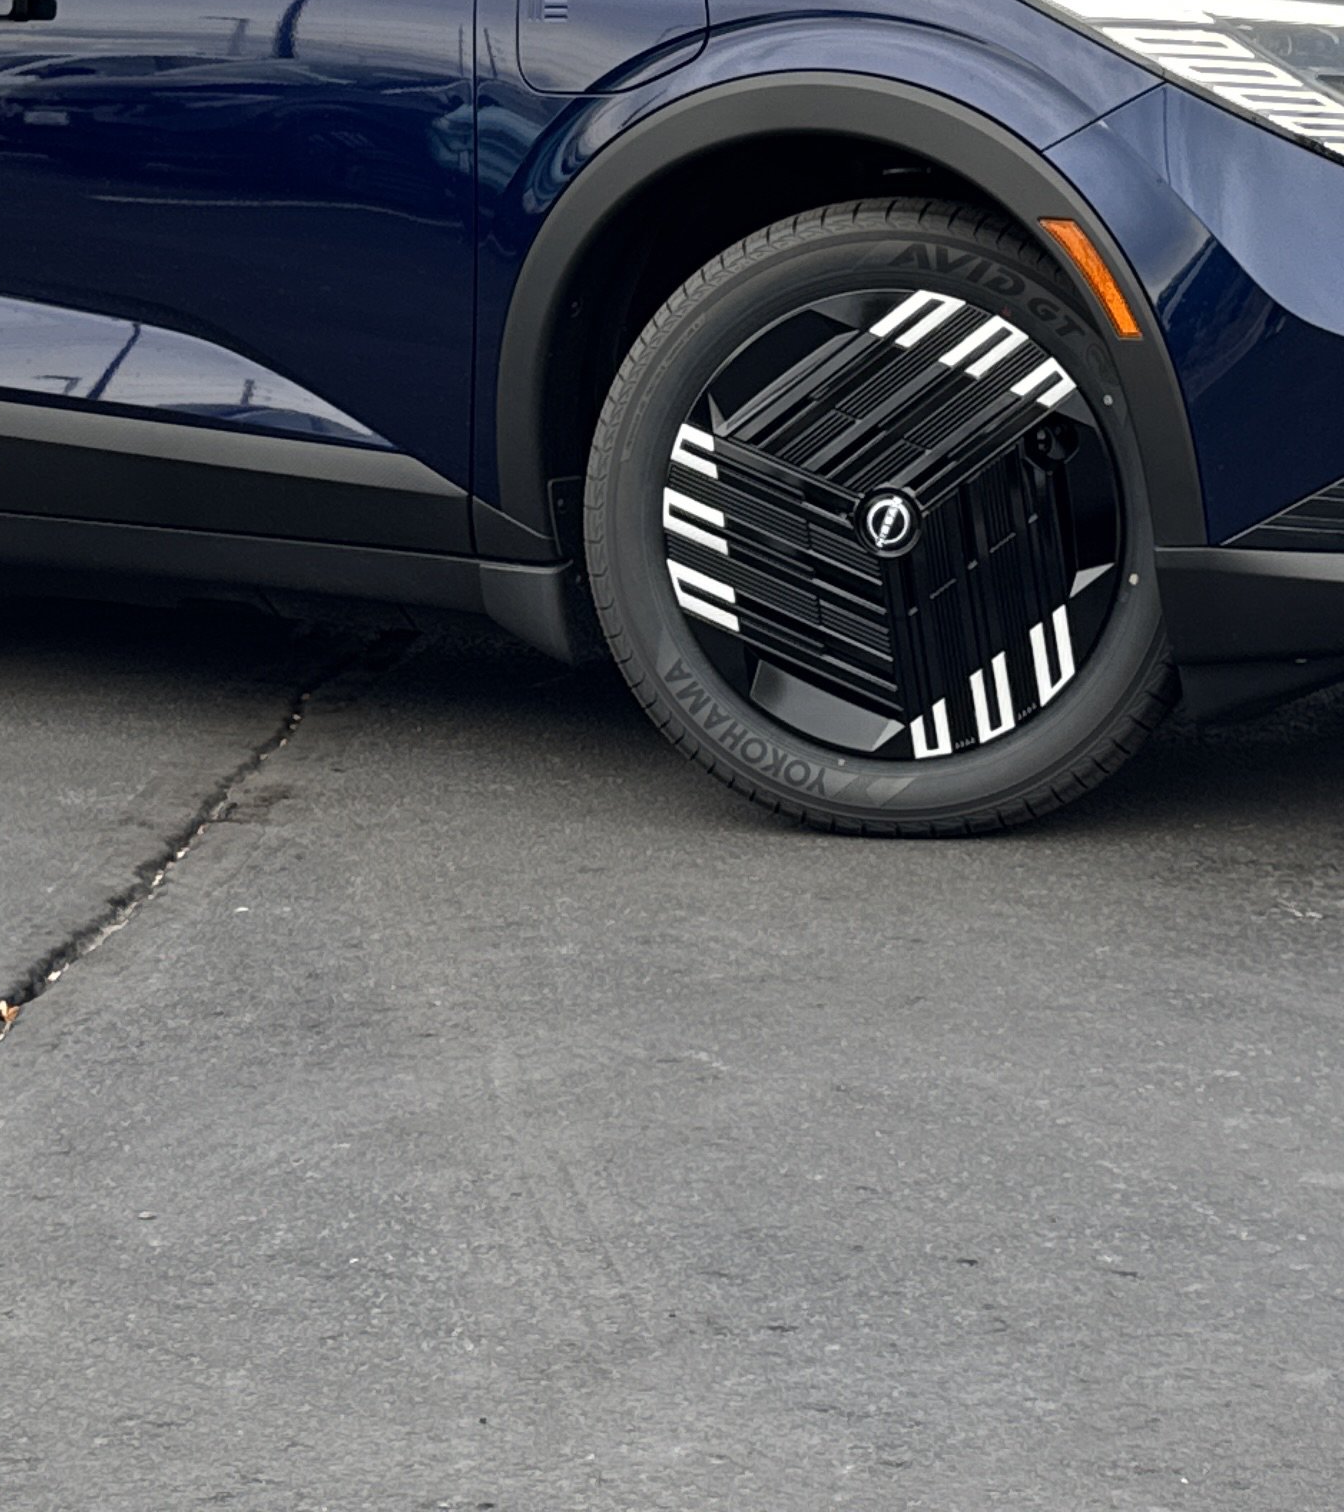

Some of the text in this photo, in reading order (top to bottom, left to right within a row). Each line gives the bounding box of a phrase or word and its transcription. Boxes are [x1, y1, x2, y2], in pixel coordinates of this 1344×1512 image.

[887, 243, 1085, 341] AVID GT
[664, 658, 826, 797] YOKOHAMA
